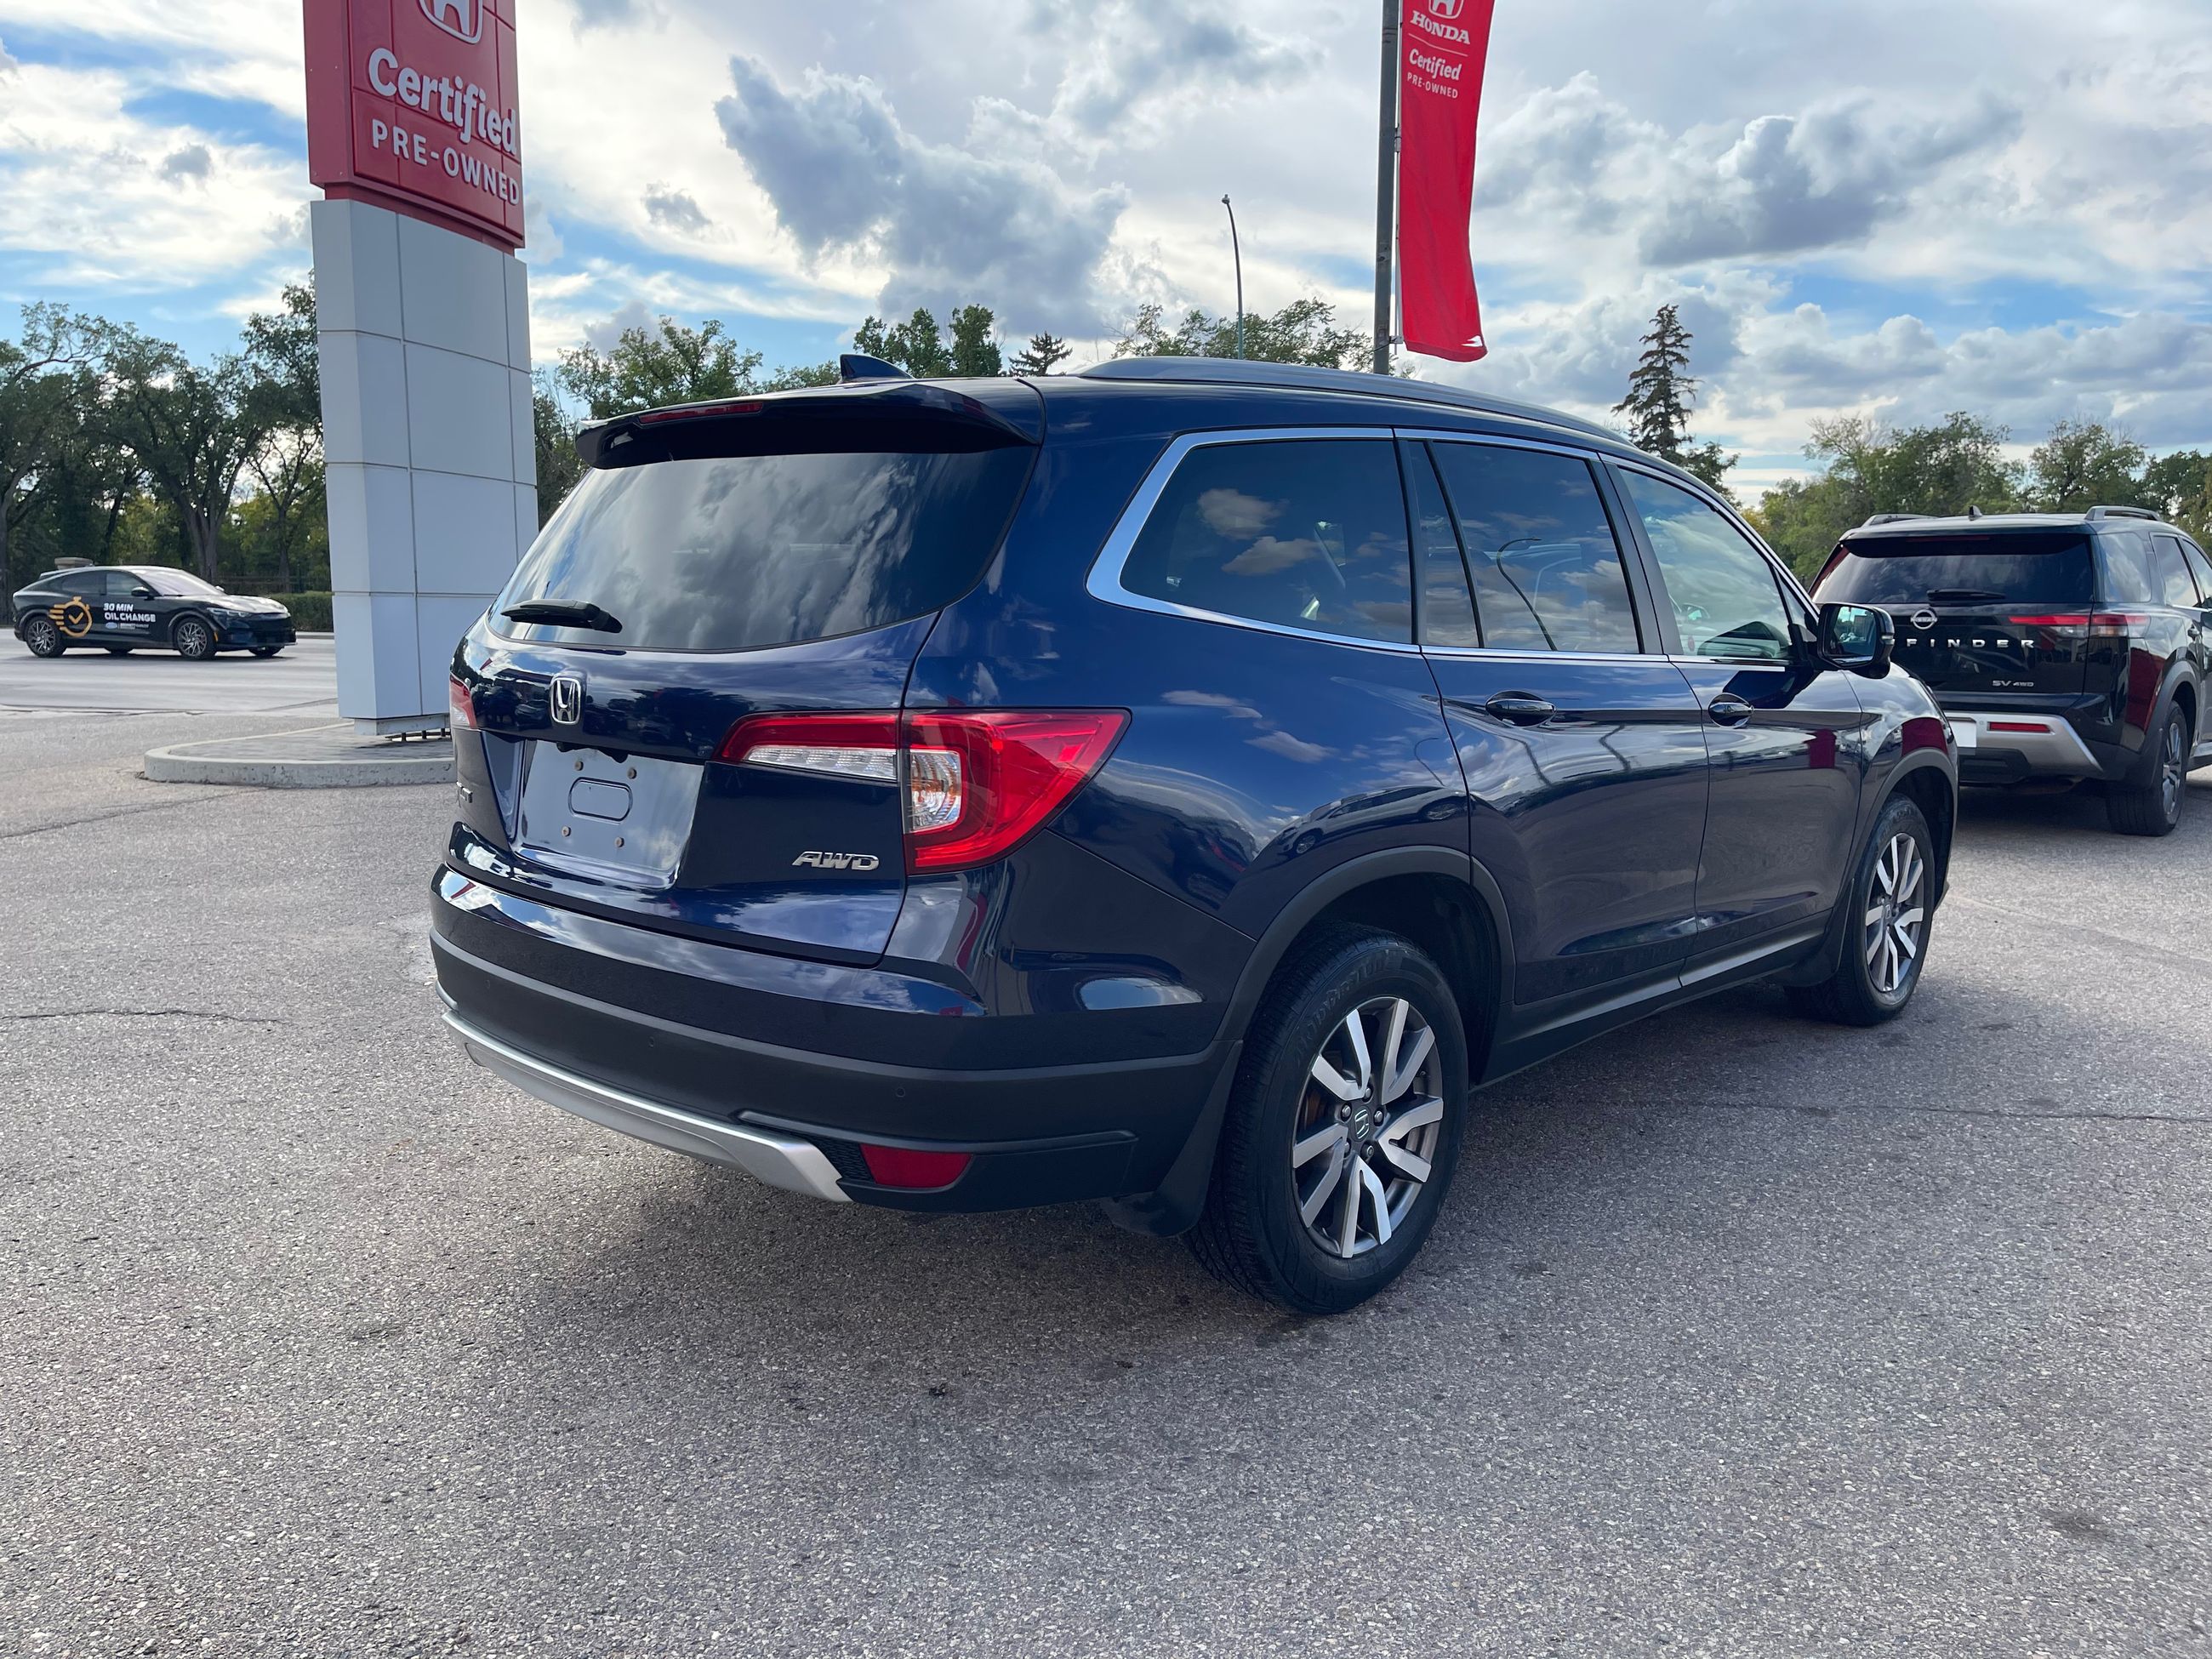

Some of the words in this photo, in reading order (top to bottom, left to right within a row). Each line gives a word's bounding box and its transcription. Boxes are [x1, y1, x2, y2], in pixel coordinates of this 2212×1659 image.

[1411, 10, 1470, 44] HONDA
[1409, 48, 1462, 80] Certified
[1407, 72, 1458, 99] PRE-OWNED
[368, 48, 517, 156] Certified
[372, 119, 520, 205] PRE-OWNED
[104, 612, 119, 621] OIL
[119, 613, 157, 623] CHANGE
[116, 603, 134, 613] MIN
[1907, 638, 2034, 648] FINDER
[792, 851, 880, 871] AWD
